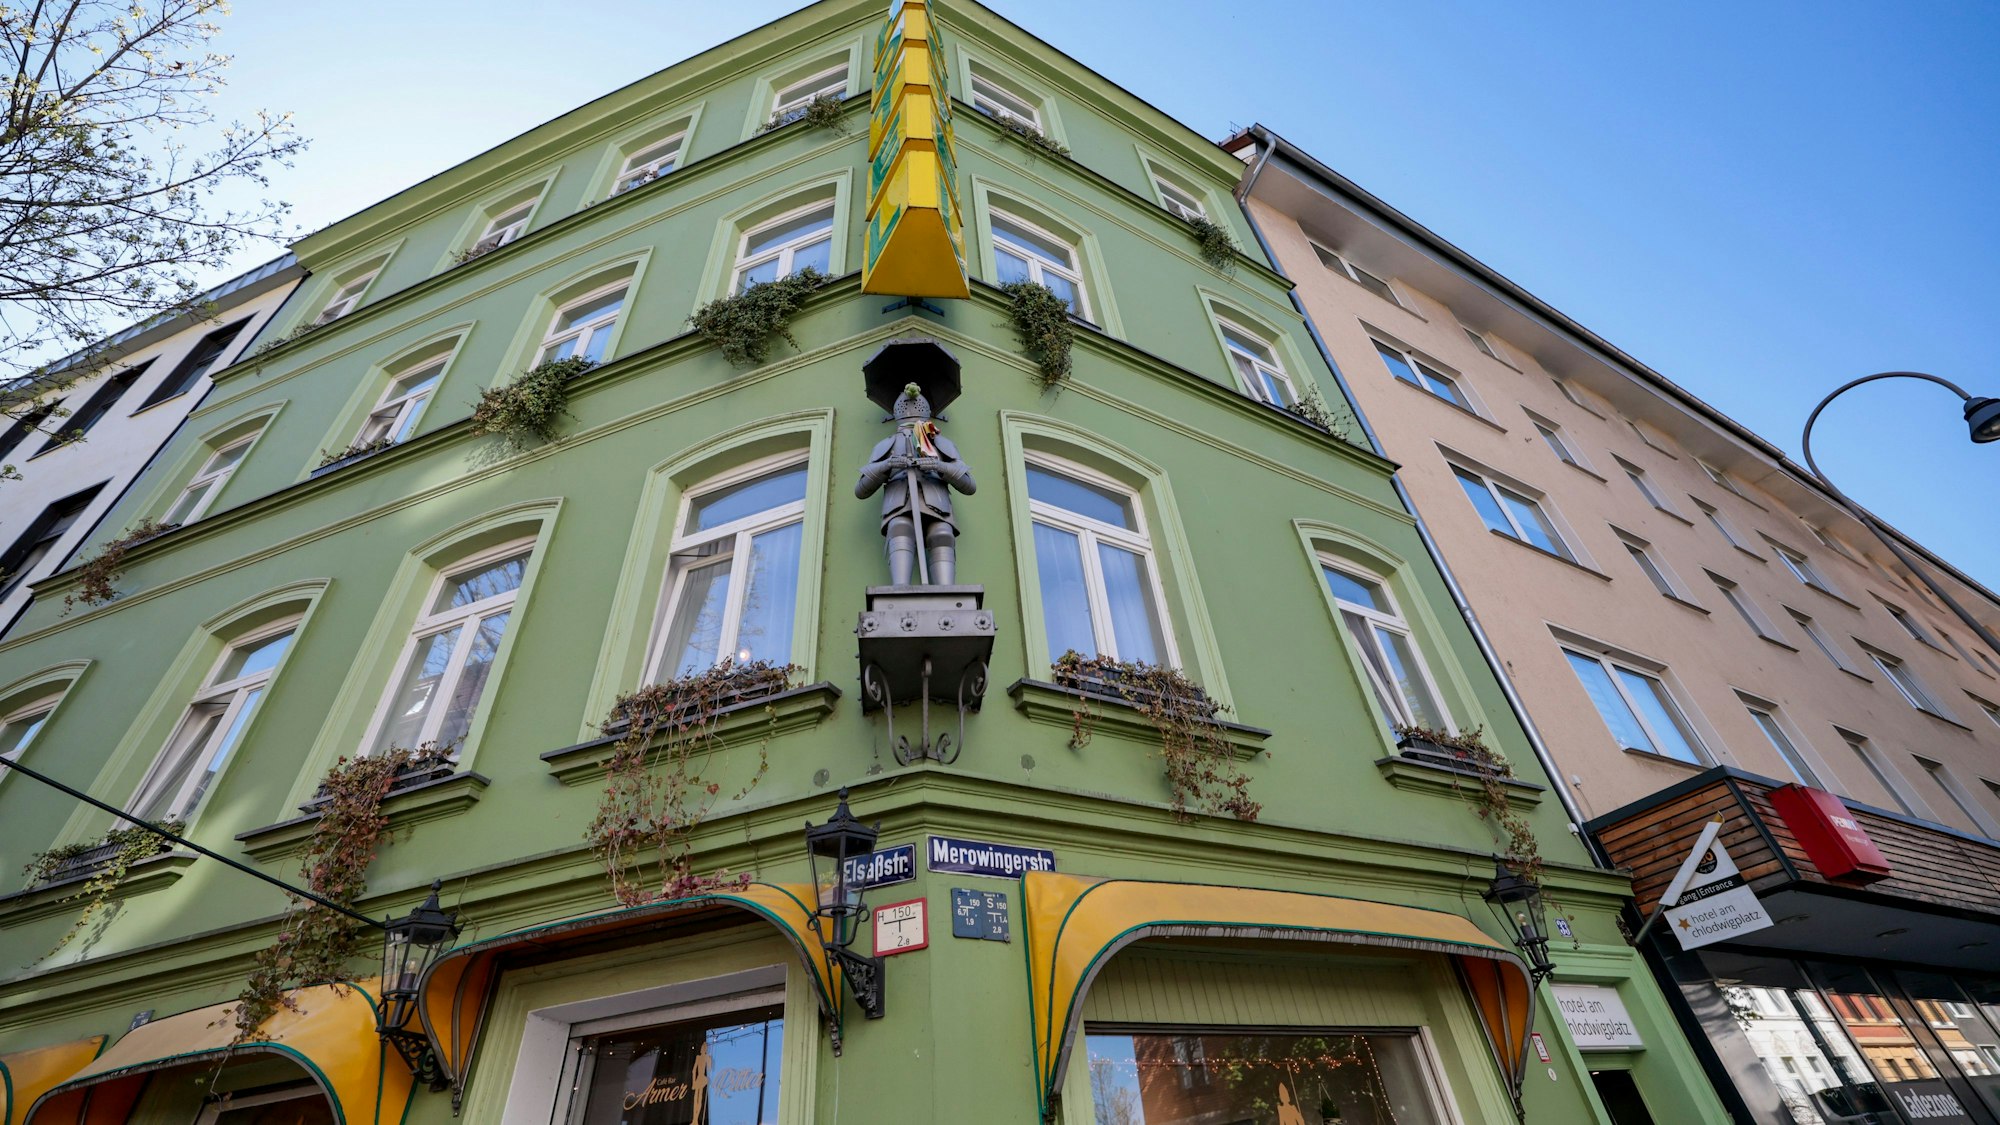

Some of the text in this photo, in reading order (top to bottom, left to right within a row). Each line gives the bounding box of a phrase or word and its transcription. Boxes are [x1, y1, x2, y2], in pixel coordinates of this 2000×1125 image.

[843, 851, 909, 882] Elsaßstr.
[877, 905, 911, 922] H 150
[970, 898, 981, 907] 150
[986, 897, 1007, 910] S 150
[1690, 903, 1737, 925] hotel am
[1691, 910, 1762, 938] chlodwigplatz
[1557, 996, 1606, 1013] hotel am
[1565, 1018, 1632, 1040] hlodwigplatz
[623, 1077, 689, 1110] Armer
